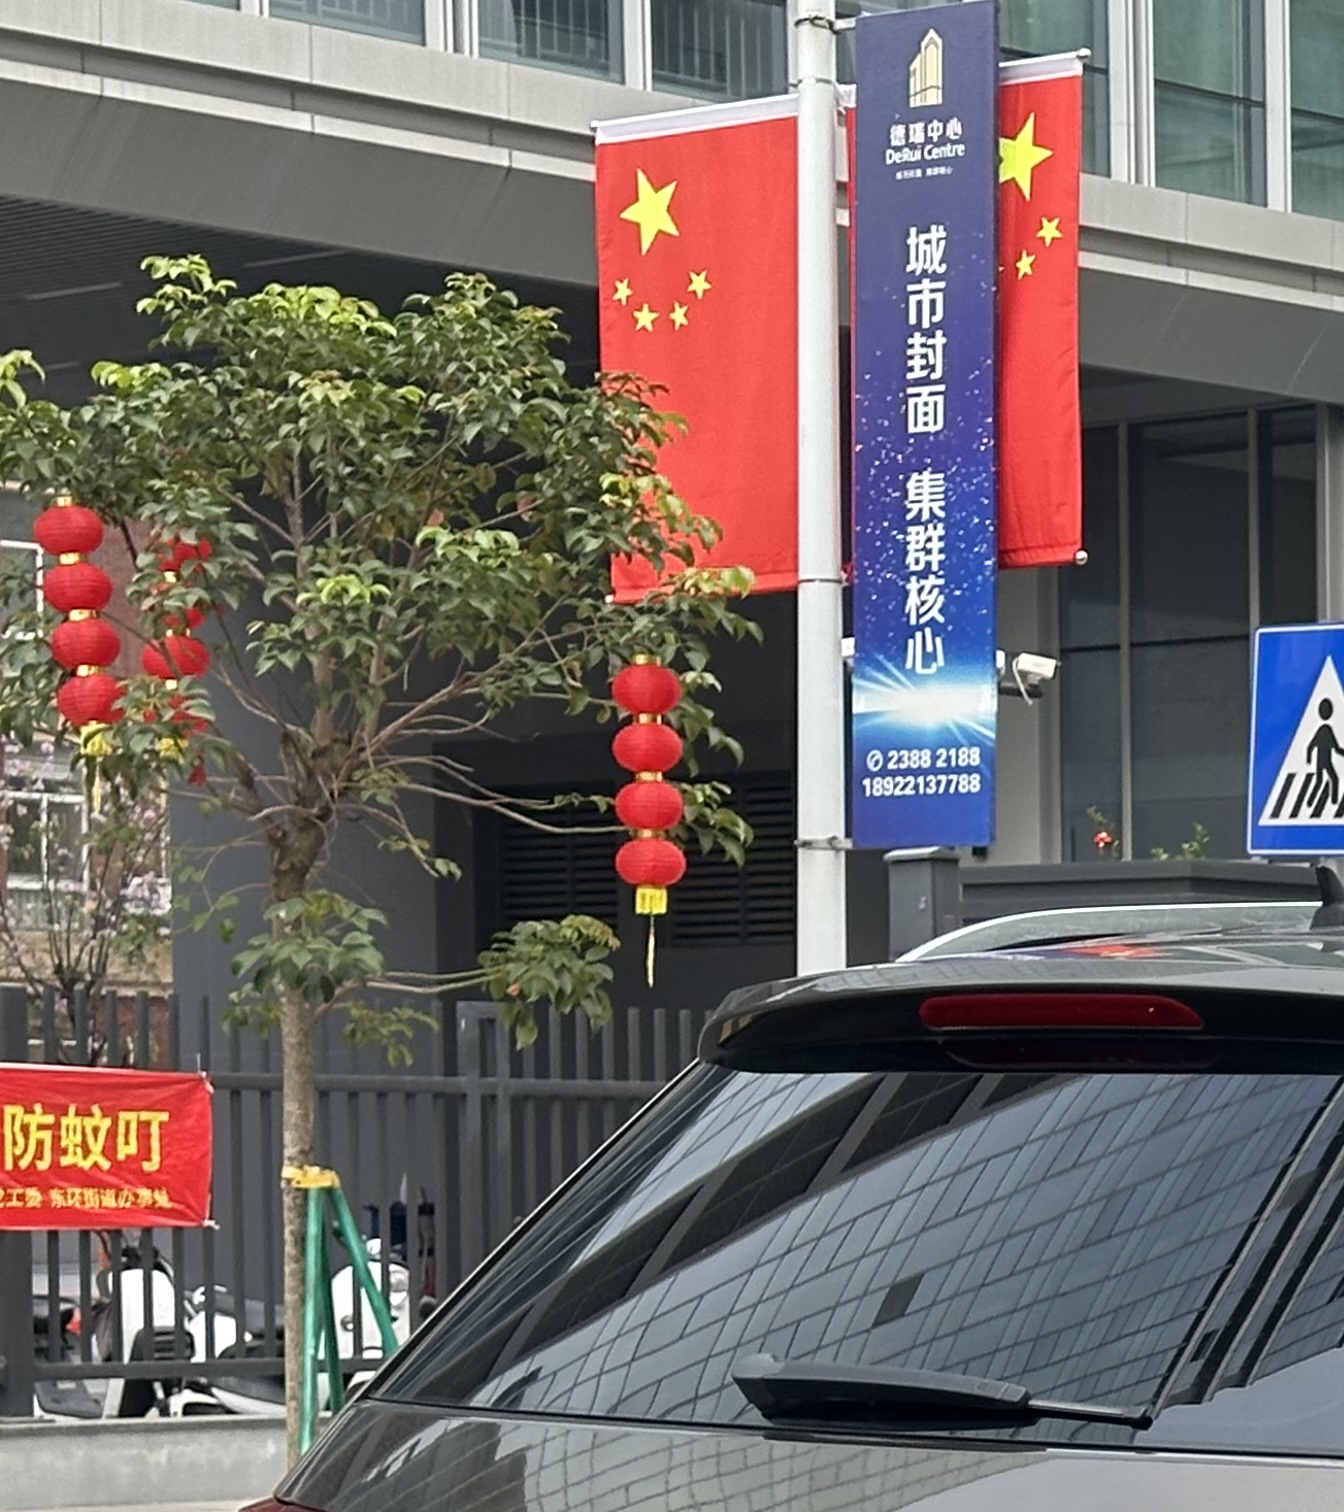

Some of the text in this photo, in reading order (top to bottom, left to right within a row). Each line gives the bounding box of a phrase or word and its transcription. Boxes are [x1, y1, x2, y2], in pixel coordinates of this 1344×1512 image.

[890, 117, 963, 146] 德瑞中心
[885, 143, 966, 165] DeRui Centre
[905, 224, 948, 434] 城市封面
[905, 470, 946, 675] 集群核心
[887, 746, 981, 770] 2388 2188
[861, 773, 981, 798] 18922137788
[3, 1102, 170, 1172] 防蚊叮
